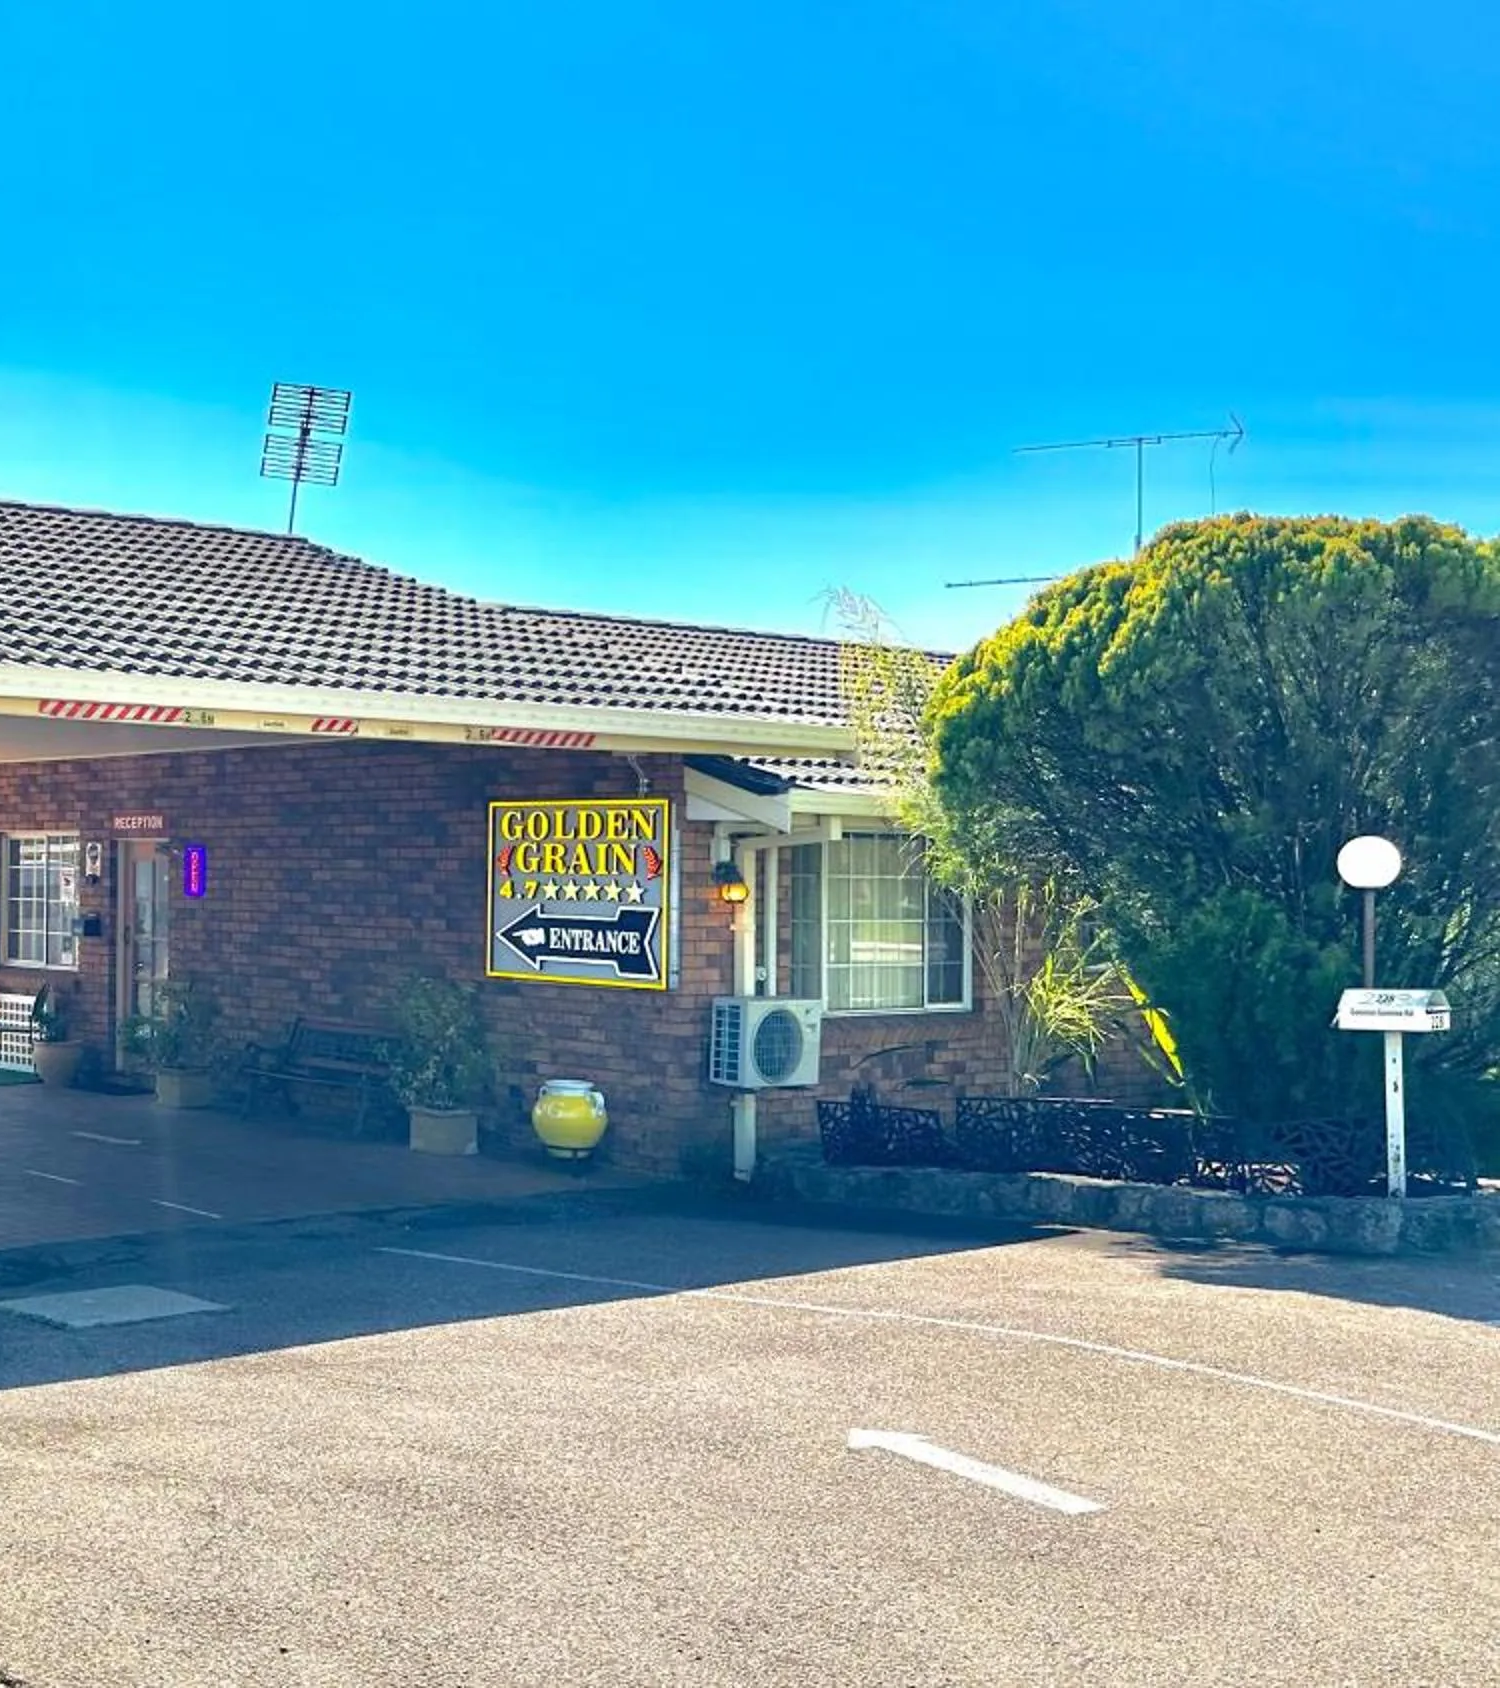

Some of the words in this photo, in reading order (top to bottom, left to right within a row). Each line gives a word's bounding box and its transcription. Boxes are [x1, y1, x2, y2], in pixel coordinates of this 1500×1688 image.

[114, 815, 163, 830] RECEPTION
[501, 810, 655, 841] GOLDEN
[515, 842, 636, 876] GRAIN
[500, 880, 538, 900] 4.7
[549, 927, 641, 954] ENTRANCE
